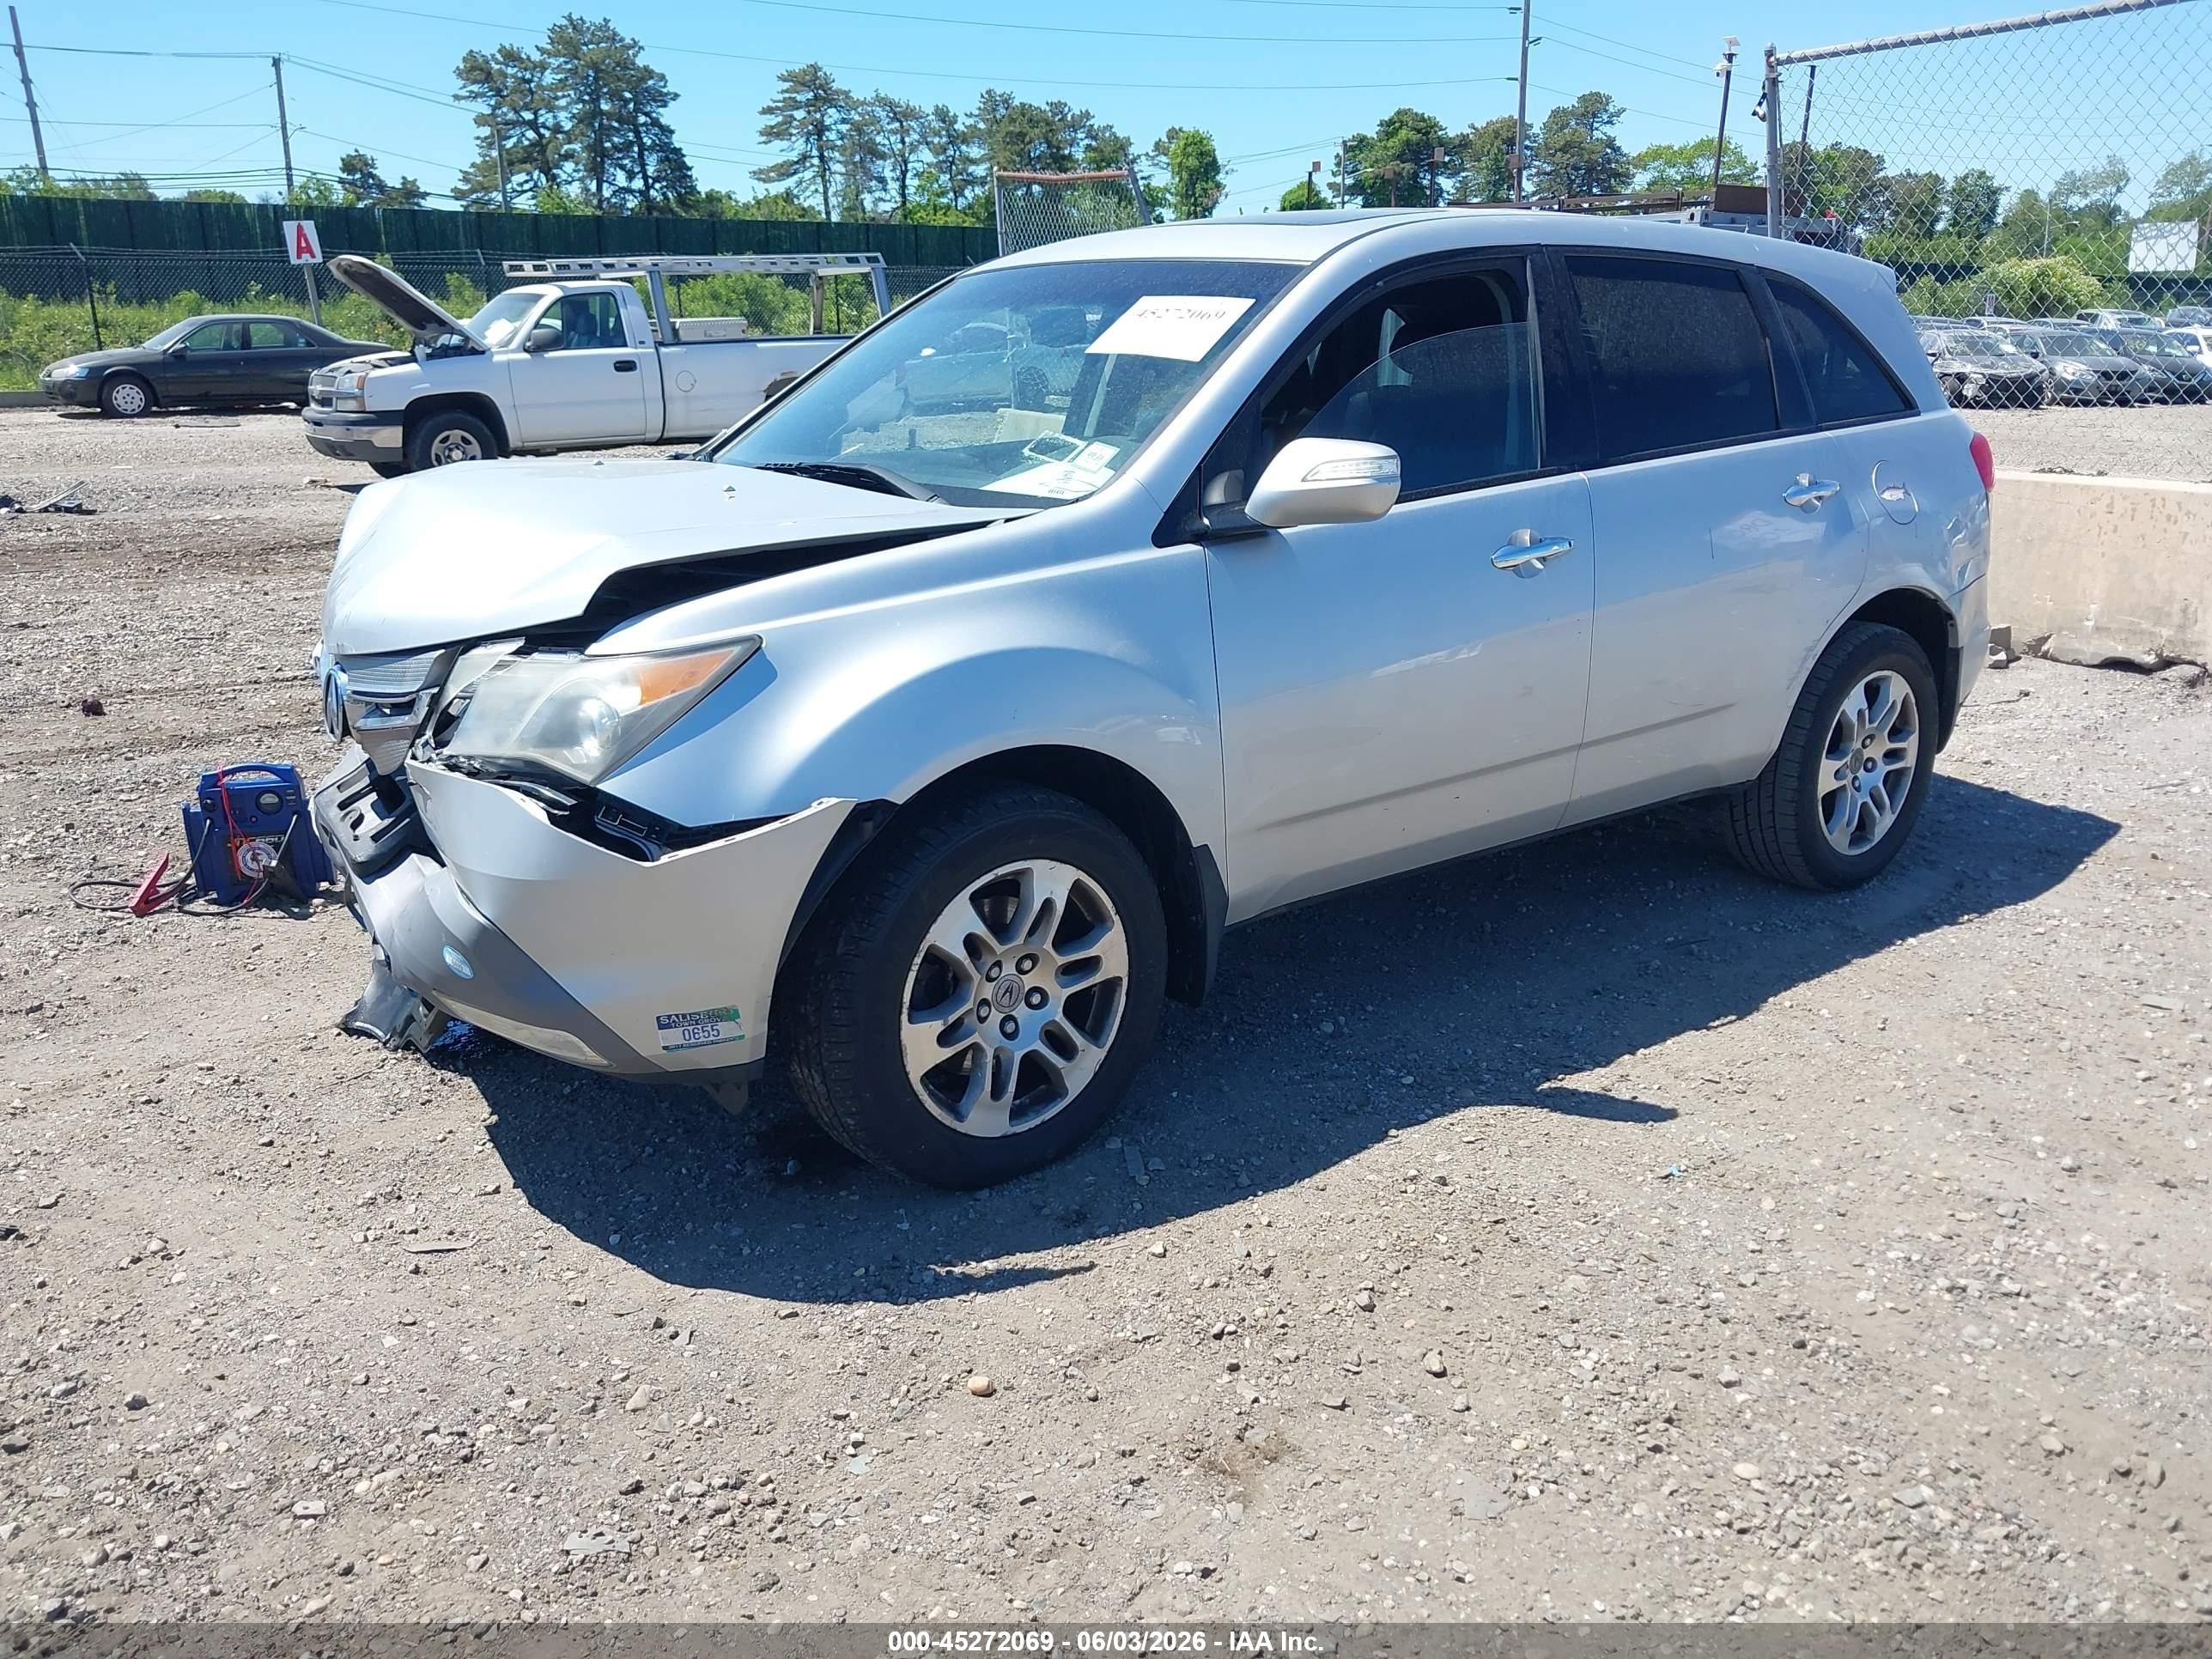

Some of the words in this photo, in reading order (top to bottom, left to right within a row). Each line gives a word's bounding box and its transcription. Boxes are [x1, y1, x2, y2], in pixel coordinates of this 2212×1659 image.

[295, 222, 317, 259] A
[671, 1020, 696, 1029] TOWN
[682, 1024, 720, 1042] 0655
